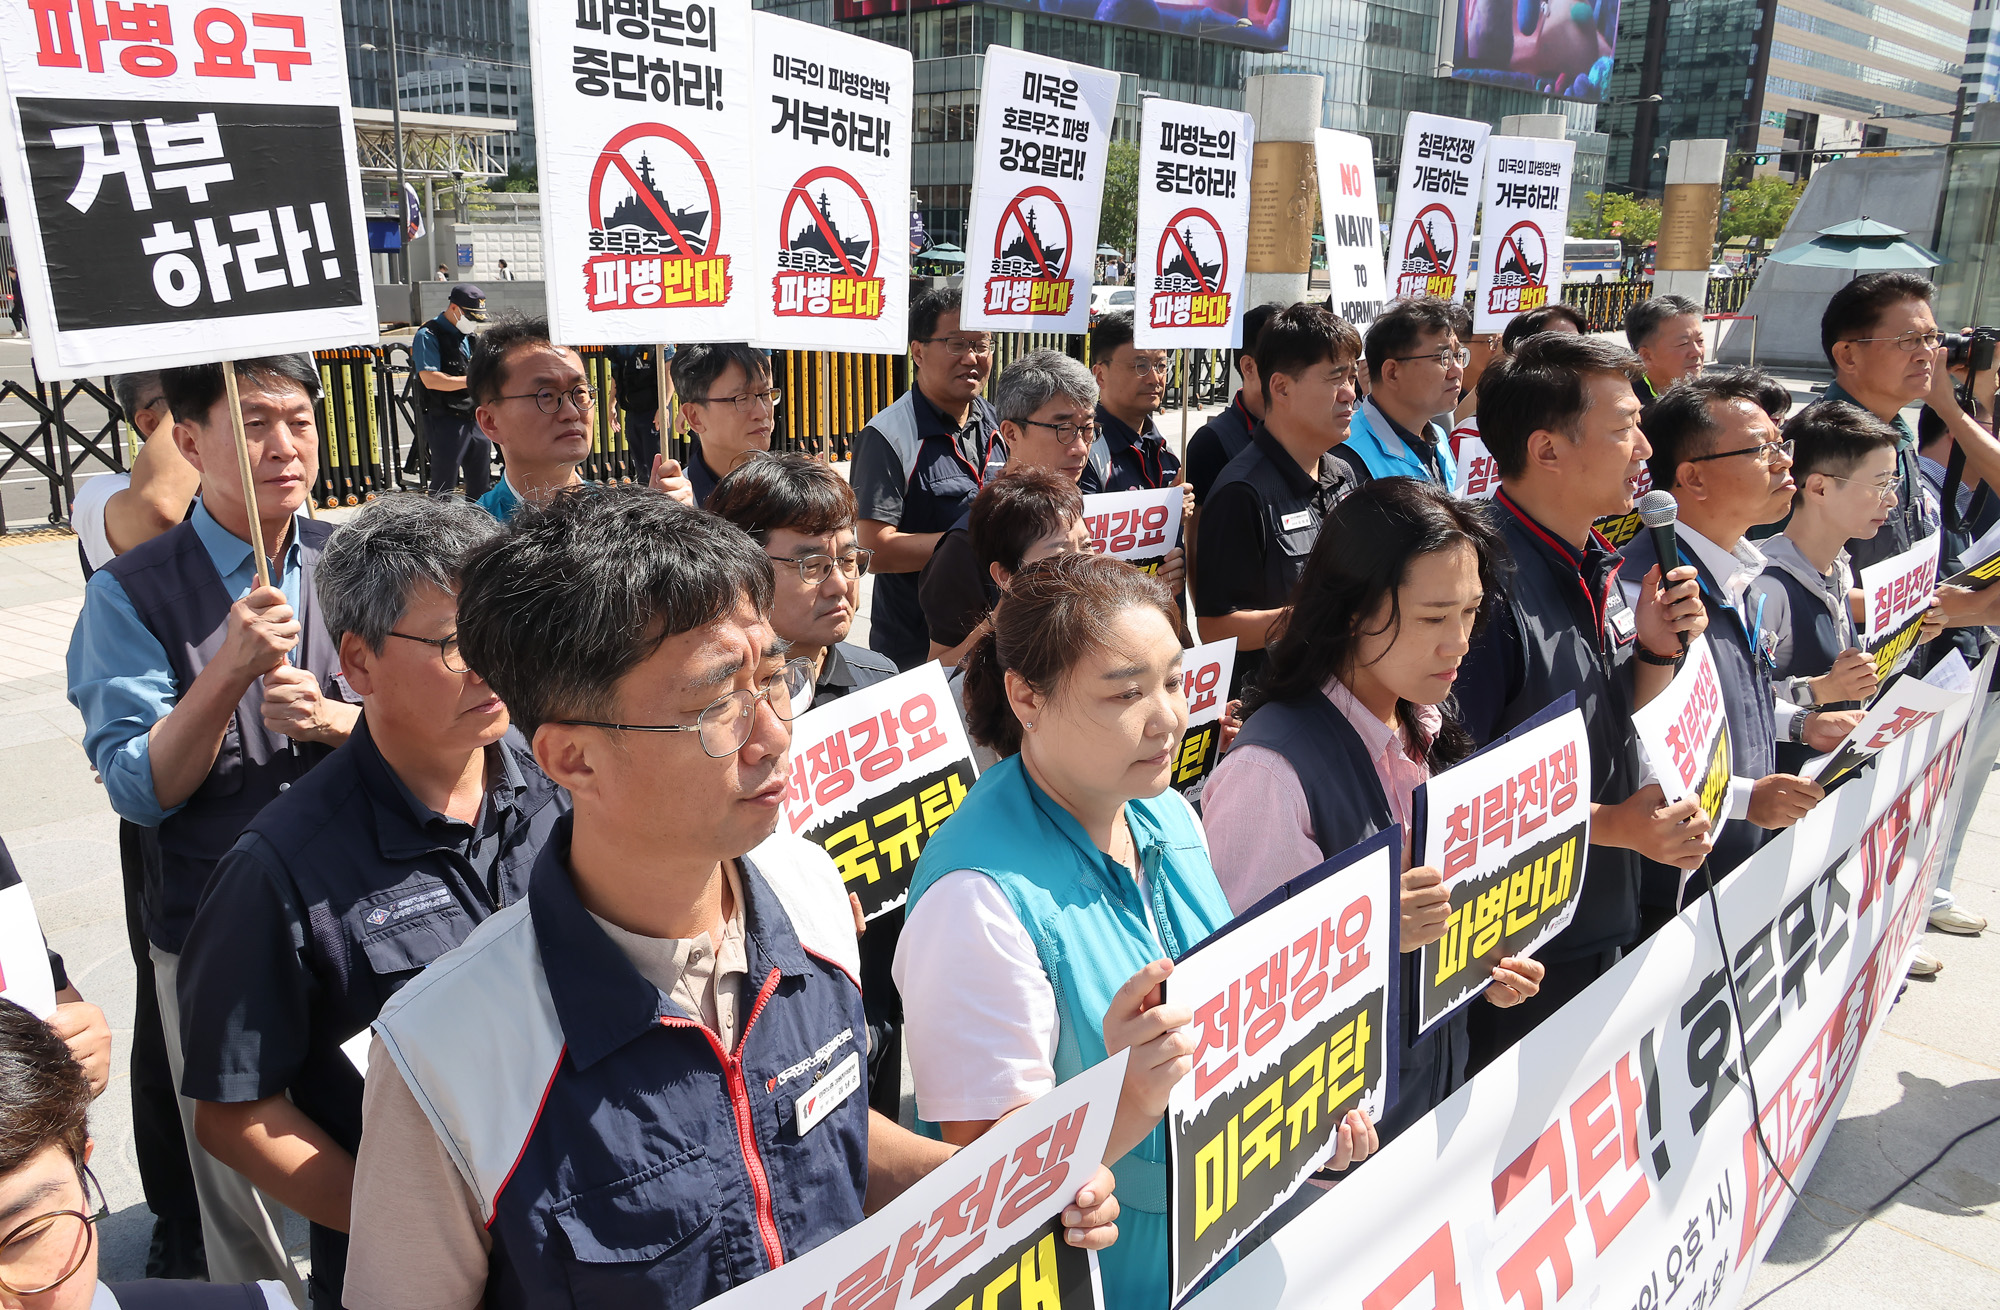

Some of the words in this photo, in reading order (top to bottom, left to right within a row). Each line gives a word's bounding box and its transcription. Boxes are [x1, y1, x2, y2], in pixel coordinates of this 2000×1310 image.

[27, 0, 177, 78] 파병
[194, 7, 312, 81] 요구
[572, 45, 724, 111] 중단하라!
[772, 54, 824, 90] 미국의
[827, 65, 891, 105] 파병압박
[1022, 71, 1079, 111] 미국은
[771, 95, 891, 158] 거부하라!
[1002, 106, 1060, 137] 호르무즈
[1062, 117, 1090, 143] 파병
[1160, 121, 1236, 160] 파병논의
[50, 112, 234, 214] 거부
[999, 136, 1087, 182] 강요말라!
[1418, 131, 1475, 165] 침략전쟁
[1155, 160, 1237, 199] 중단하라!
[1339, 162, 1362, 198] NO
[1412, 165, 1469, 197] 가담하는
[1498, 158, 1527, 175] 미국의
[1528, 161, 1561, 178] 파병압박
[1495, 183, 1560, 210] 거부하라!
[588, 228, 661, 255] 호르무즈
[1335, 213, 1374, 249] NAVY
[141, 201, 342, 307] 하라!
[776, 249, 832, 273] 호르무즈
[990, 258, 1033, 279] 호르무즈
[1401, 258, 1430, 274] 호르무즈
[591, 256, 727, 306] 파병반대
[777, 273, 881, 317] 파병반대
[1153, 275, 1192, 293] 호르무즈
[1353, 263, 1368, 288] TO
[1492, 273, 1522, 286] 호르무즈
[987, 278, 1070, 313] 파병반대
[1153, 291, 1228, 326] 파병반대
[1490, 285, 1547, 312] 파병반대
[326, 383, 334, 424] POLICE
[367, 382, 375, 422] POLICE
[1665, 651, 1719, 790] 침략전쟁
[1442, 740, 1579, 882] 침략전쟁
[1434, 836, 1578, 988] 파병반대
[1192, 894, 1373, 1102] 전쟁강요
[1680, 849, 1851, 1137] 호르무즈
[1194, 1008, 1372, 1242] 미국규탄
[1665, 1216, 1704, 1306] 오후
[1705, 1168, 1733, 1241] 1시
